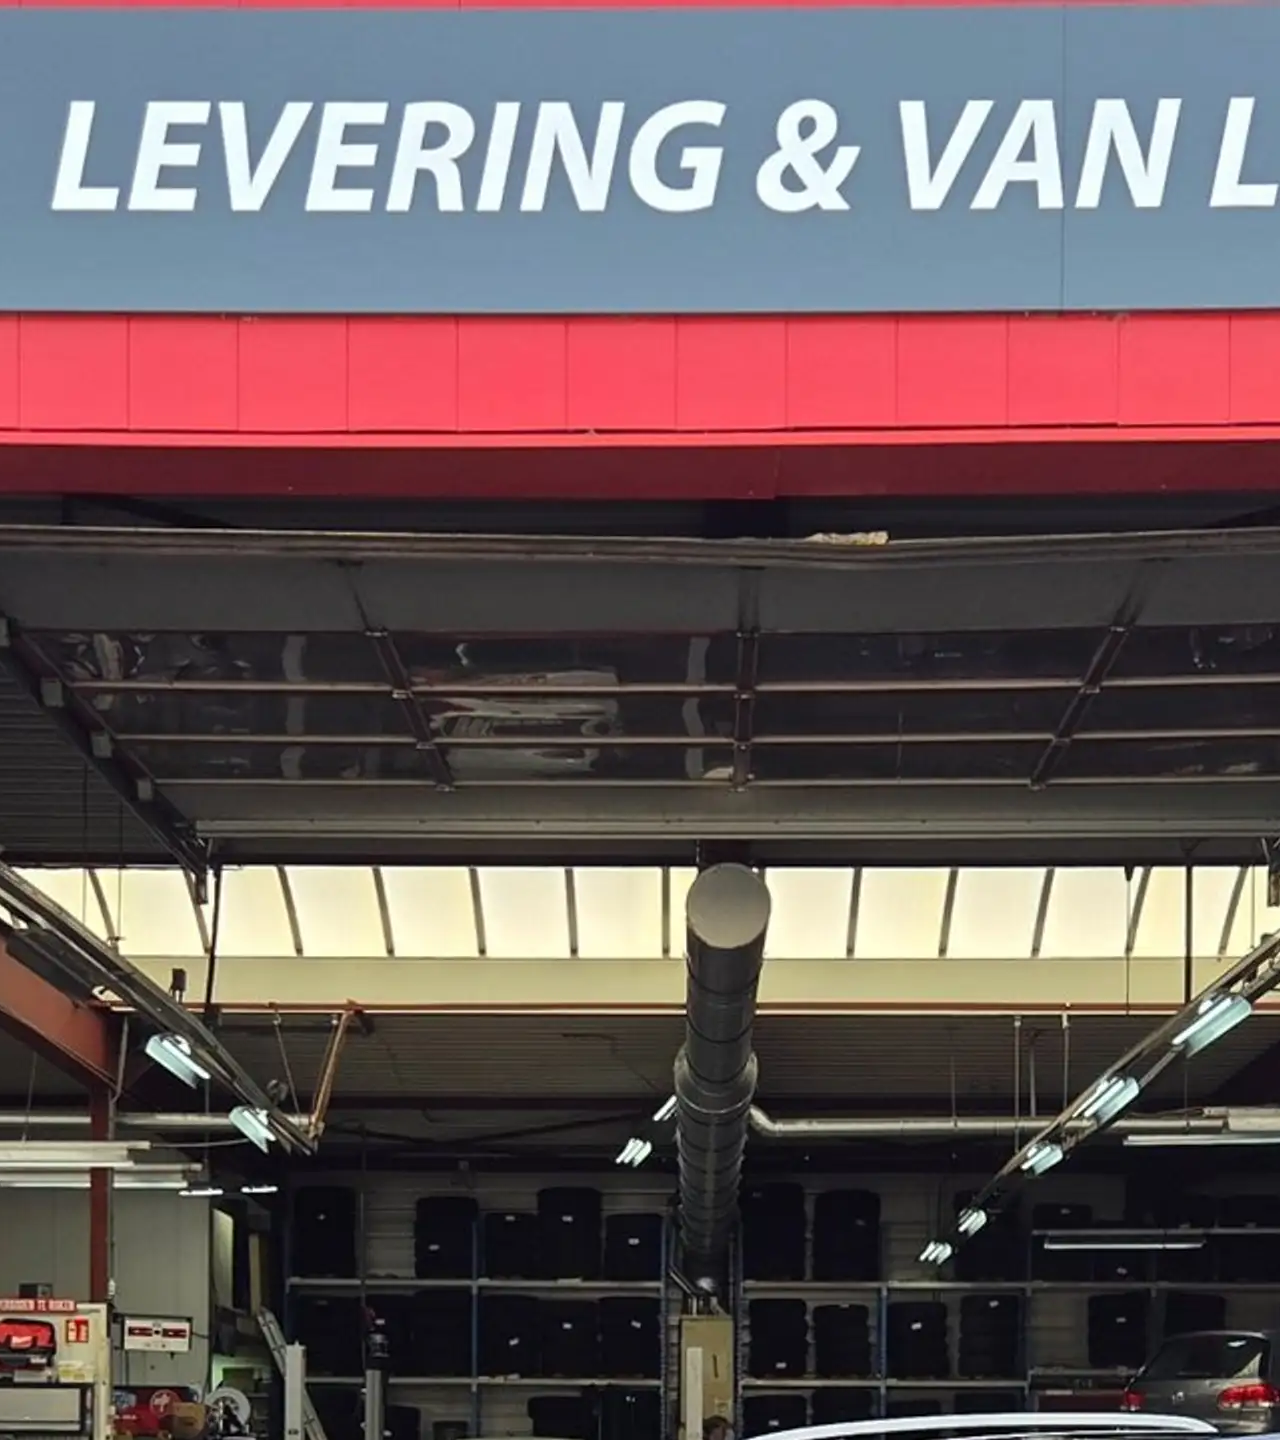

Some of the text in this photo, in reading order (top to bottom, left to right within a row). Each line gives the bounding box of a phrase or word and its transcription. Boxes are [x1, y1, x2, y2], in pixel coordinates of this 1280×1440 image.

[50, 98, 727, 213] LEVERING
[754, 98, 861, 212] &
[899, 98, 1181, 211] VAN
